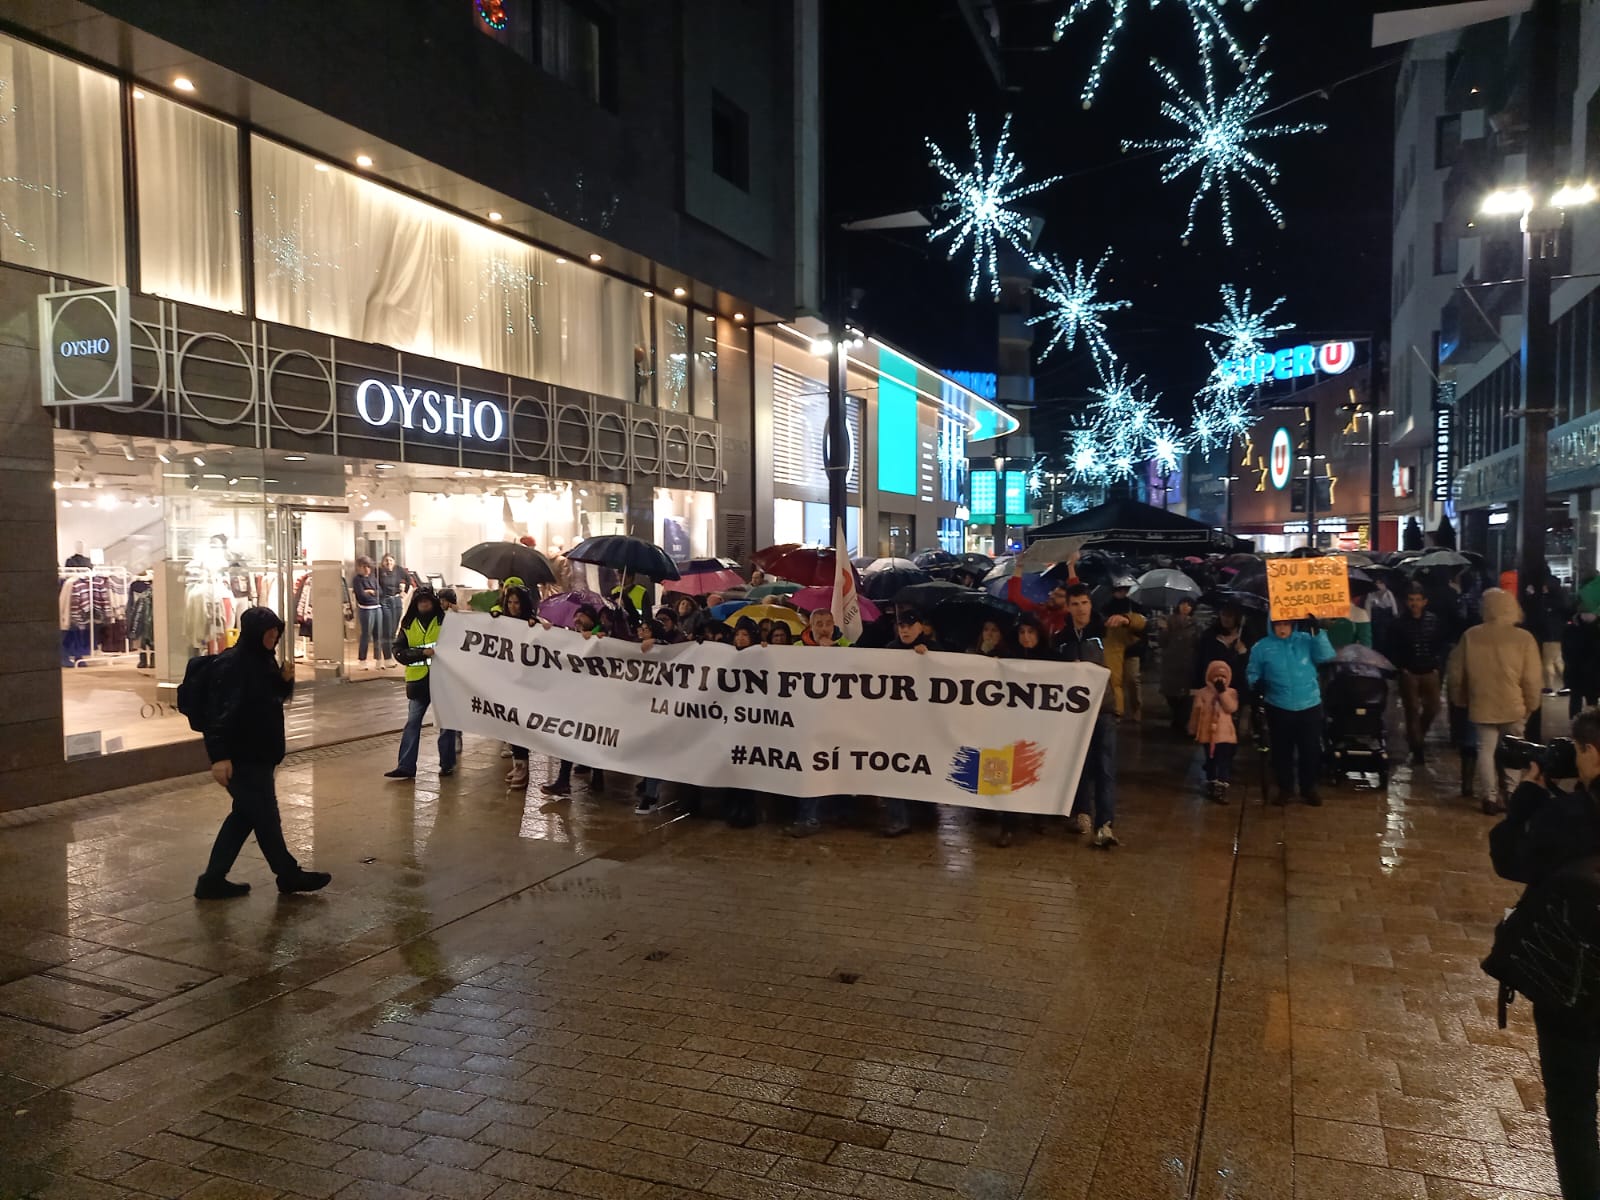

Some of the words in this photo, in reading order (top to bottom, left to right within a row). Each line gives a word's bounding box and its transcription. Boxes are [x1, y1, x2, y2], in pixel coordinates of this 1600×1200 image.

[60, 338, 110, 357] OYSHO
[1325, 344, 1342, 366] U
[356, 379, 503, 442] OYSHO
[460, 630, 515, 663] PER
[520, 643, 563, 671] UN
[566, 653, 695, 689] PRESENT
[698, 666, 710, 691] I
[717, 667, 769, 695] UN
[778, 671, 918, 702] FUTUR
[928, 677, 1091, 714] DIGNES
[471, 696, 520, 726] #ARA
[526, 712, 620, 748] DECIDIM
[650, 698, 669, 715] LA
[674, 701, 728, 724] UNIÓ,
[734, 706, 795, 728] SUMA
[731, 745, 803, 772] #ARA
[812, 746, 840, 772] SÍ
[850, 751, 932, 775] TOCA
